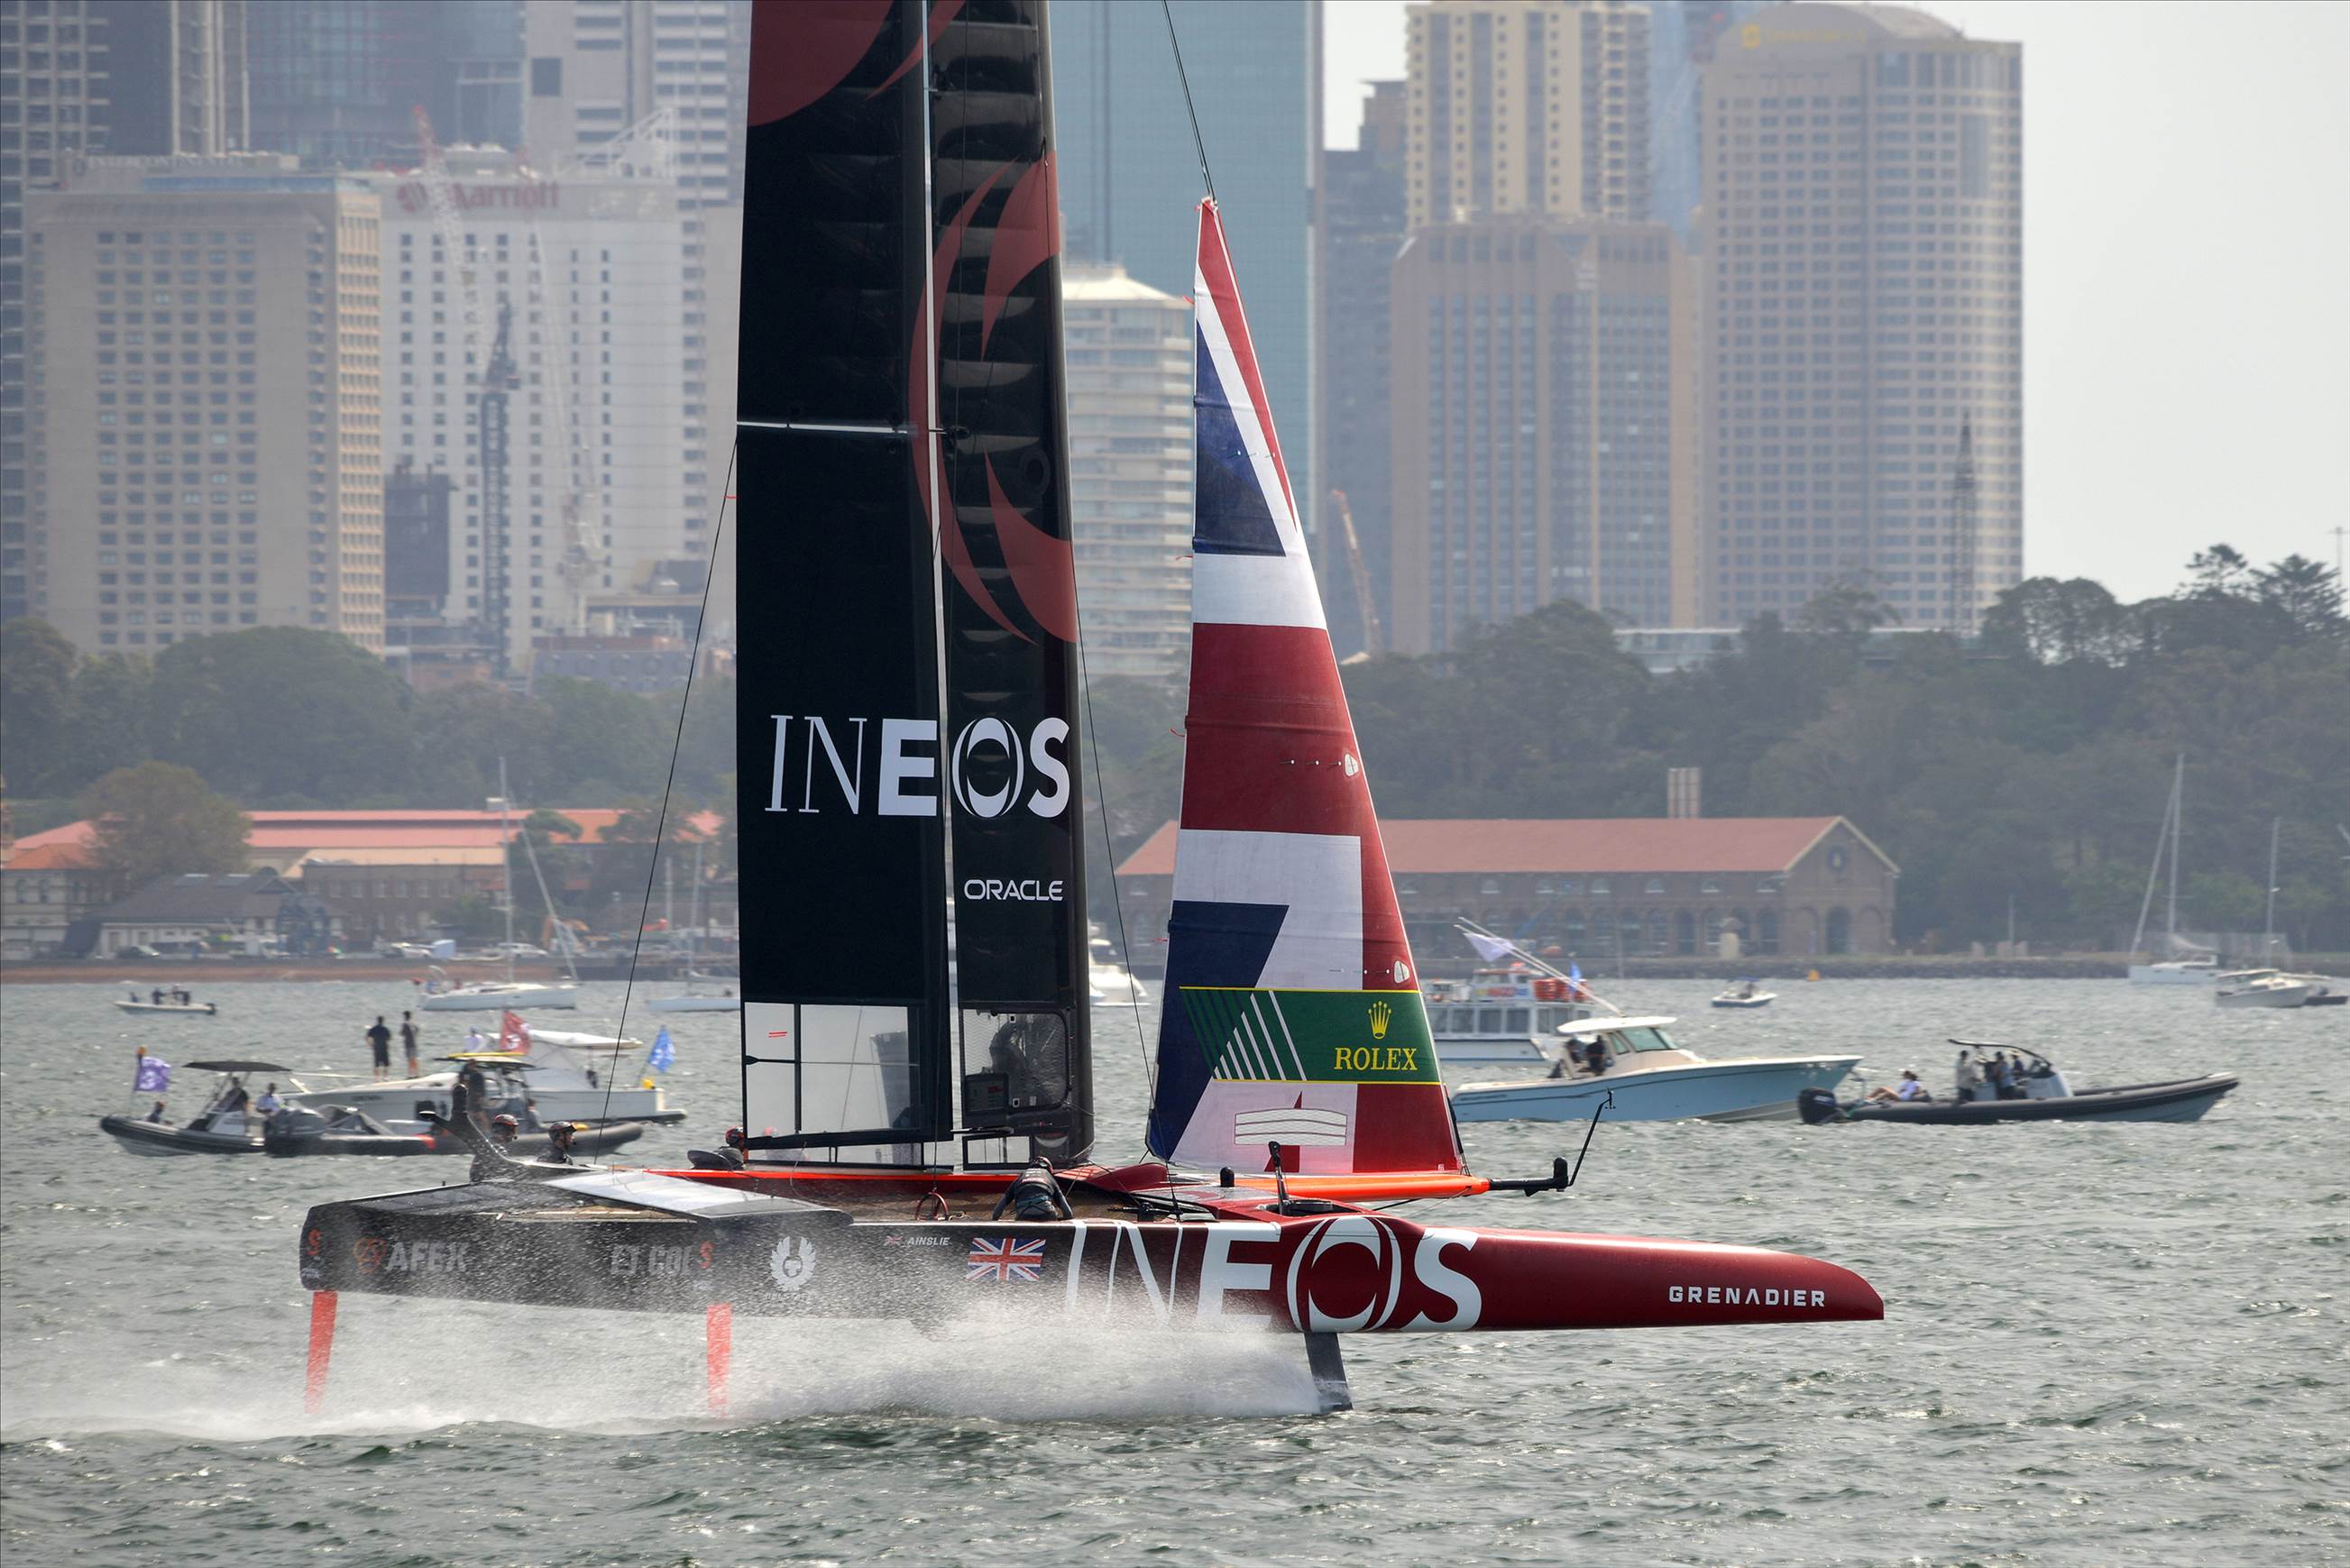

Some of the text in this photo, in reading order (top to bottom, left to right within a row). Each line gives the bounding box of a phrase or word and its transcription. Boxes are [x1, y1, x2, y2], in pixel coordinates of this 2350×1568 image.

[765, 715, 1070, 818] INEOS
[963, 879, 1064, 902] ORACLE
[1334, 1047, 1418, 1071] ROLEX
[907, 1236, 950, 1246] AINSLIE
[1066, 1215, 1483, 1333] INEOS
[1668, 1286, 1825, 1307] GRENADIER
